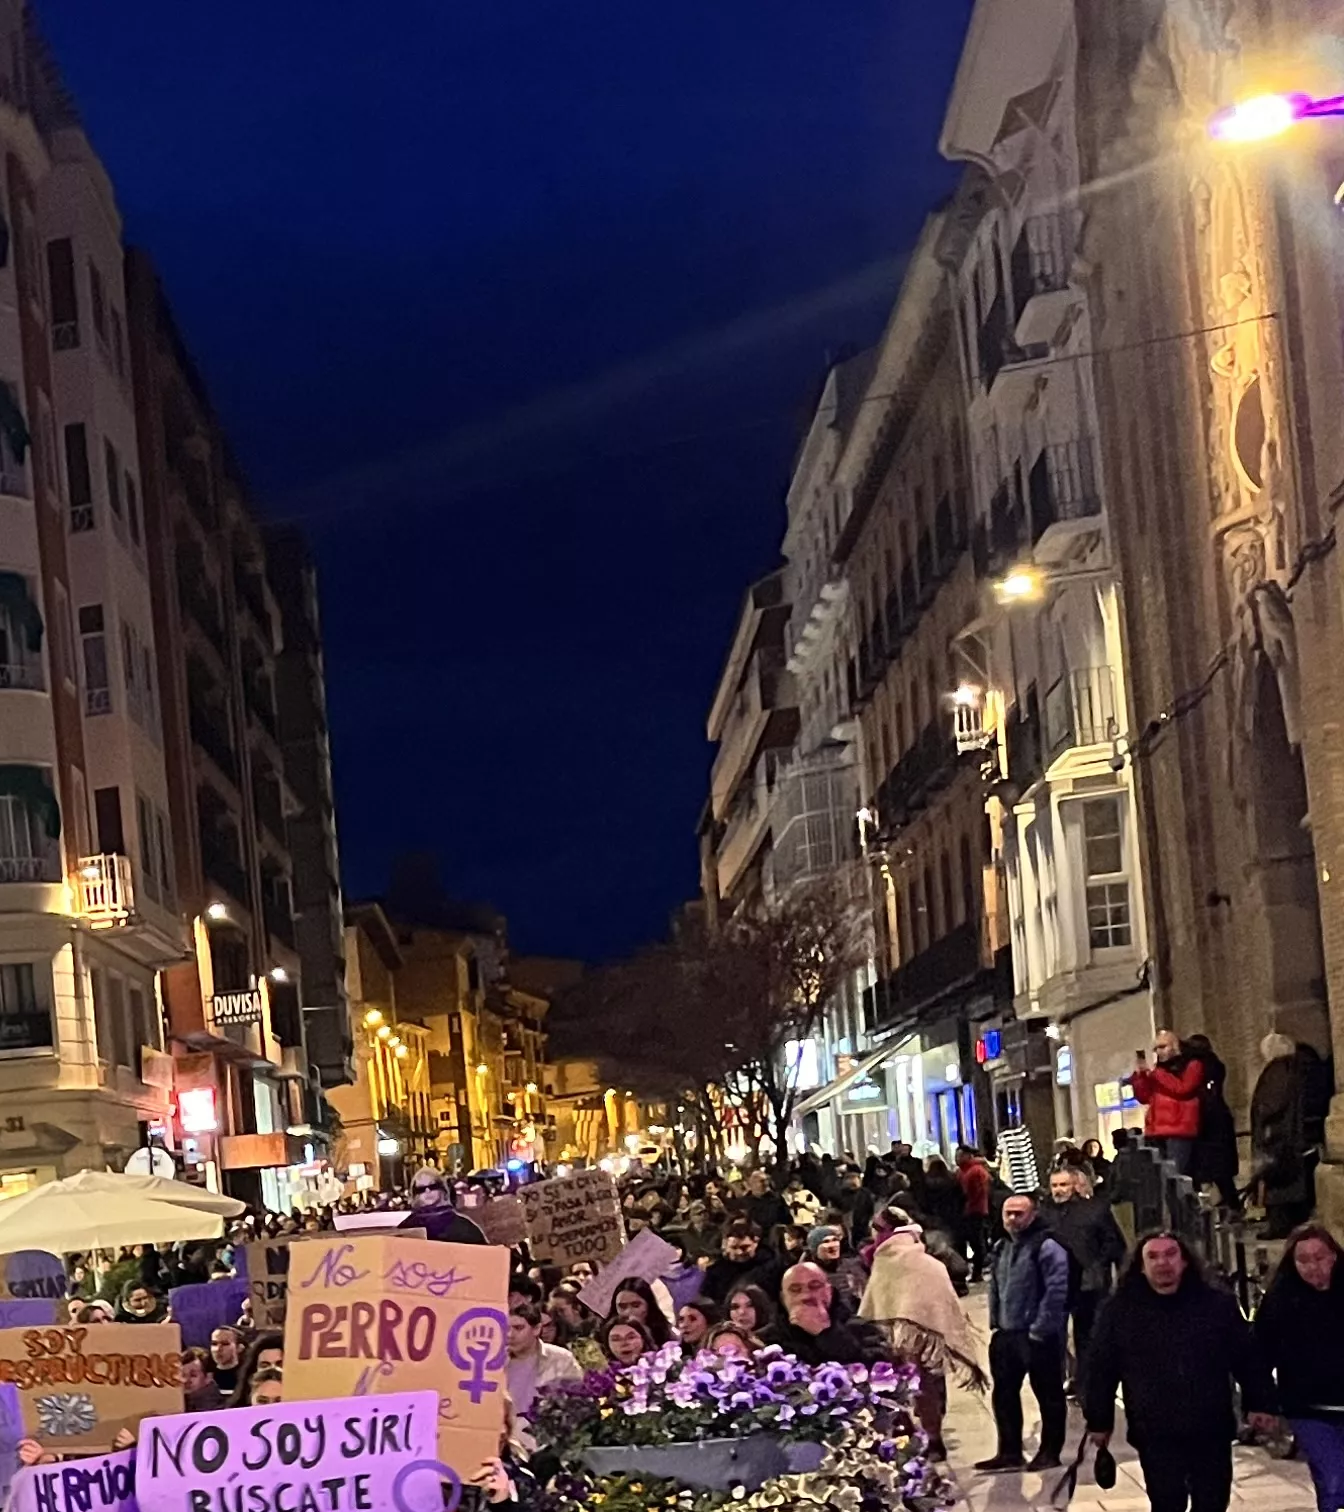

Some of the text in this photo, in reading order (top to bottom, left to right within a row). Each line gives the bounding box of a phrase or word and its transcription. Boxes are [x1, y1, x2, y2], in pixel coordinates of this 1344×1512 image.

[214, 991, 261, 1017] DUVISA
[564, 1235, 607, 1257] TODO
[300, 1243, 371, 1289] No
[382, 1257, 472, 1297] soy
[24, 1328, 88, 1358] SOY
[298, 1299, 437, 1363] PERRO
[150, 1421, 230, 1479] NO
[242, 1414, 327, 1472] SOY
